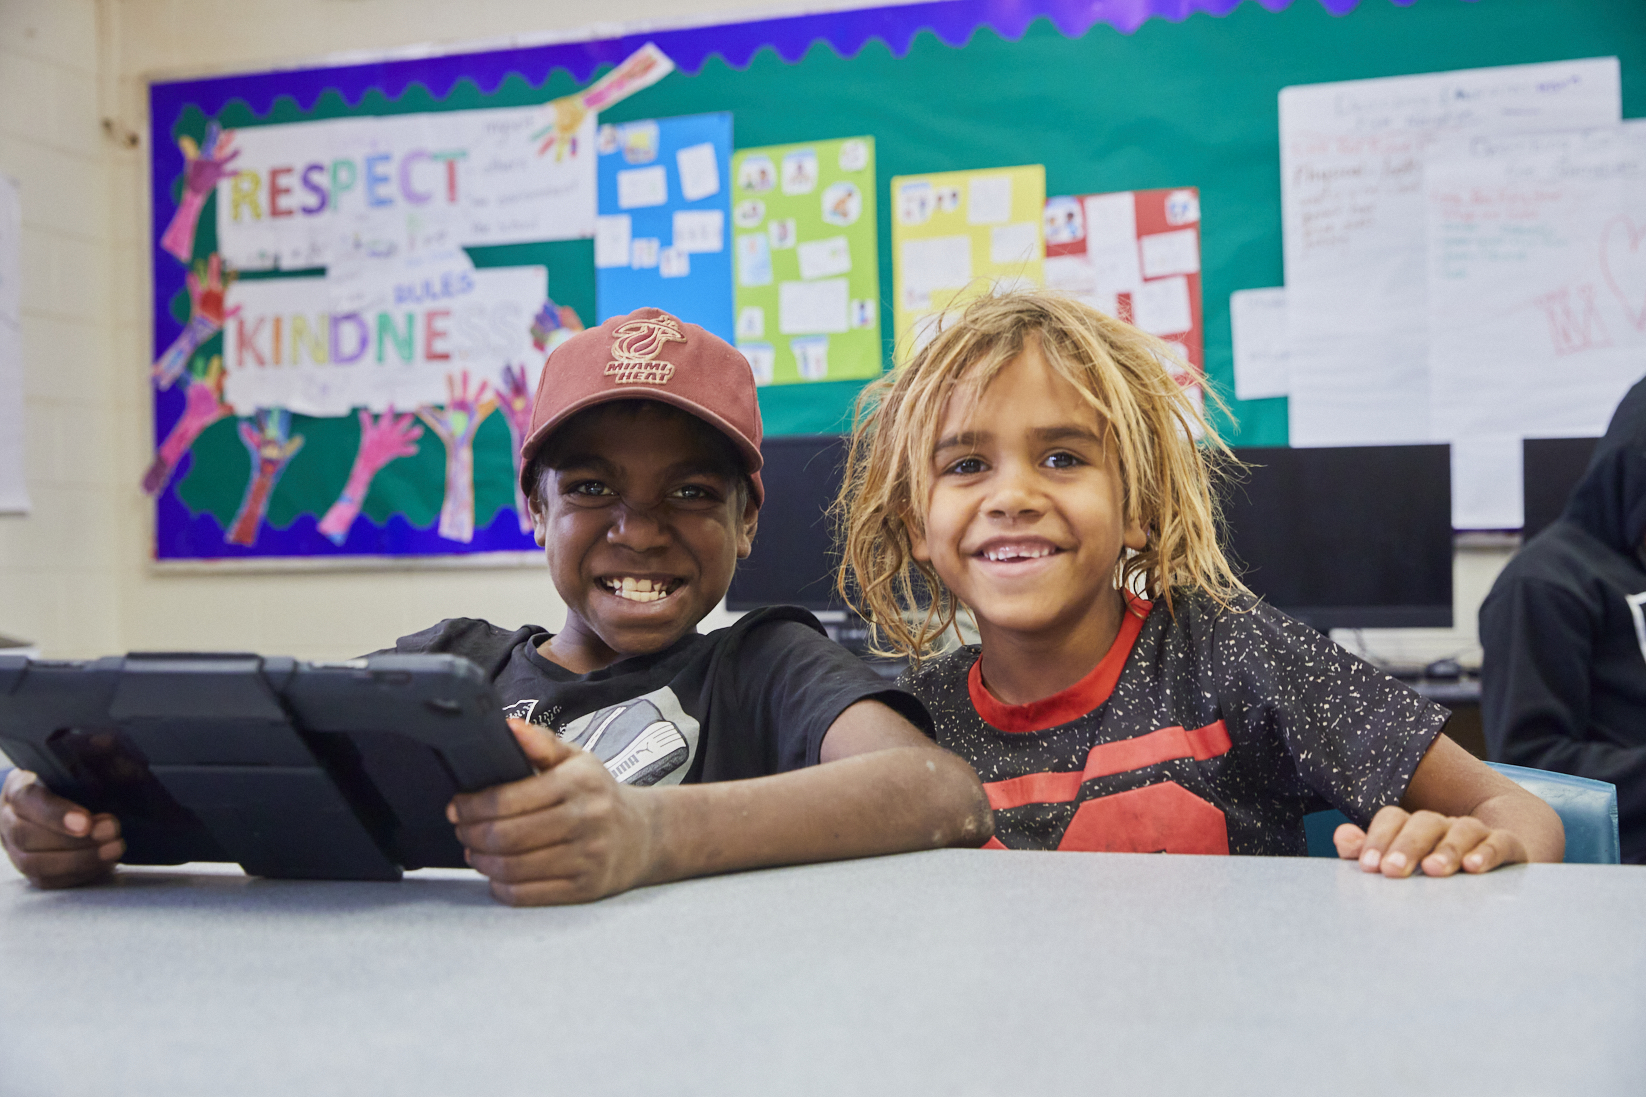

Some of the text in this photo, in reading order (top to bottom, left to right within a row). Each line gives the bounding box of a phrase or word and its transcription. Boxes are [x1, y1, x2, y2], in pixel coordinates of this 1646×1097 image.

[231, 149, 468, 221] RESPECT
[235, 299, 523, 368] KINDNESS
[605, 361, 669, 373] MIAMI
[616, 371, 673, 382] HEAT
[611, 754, 639, 778] MA
